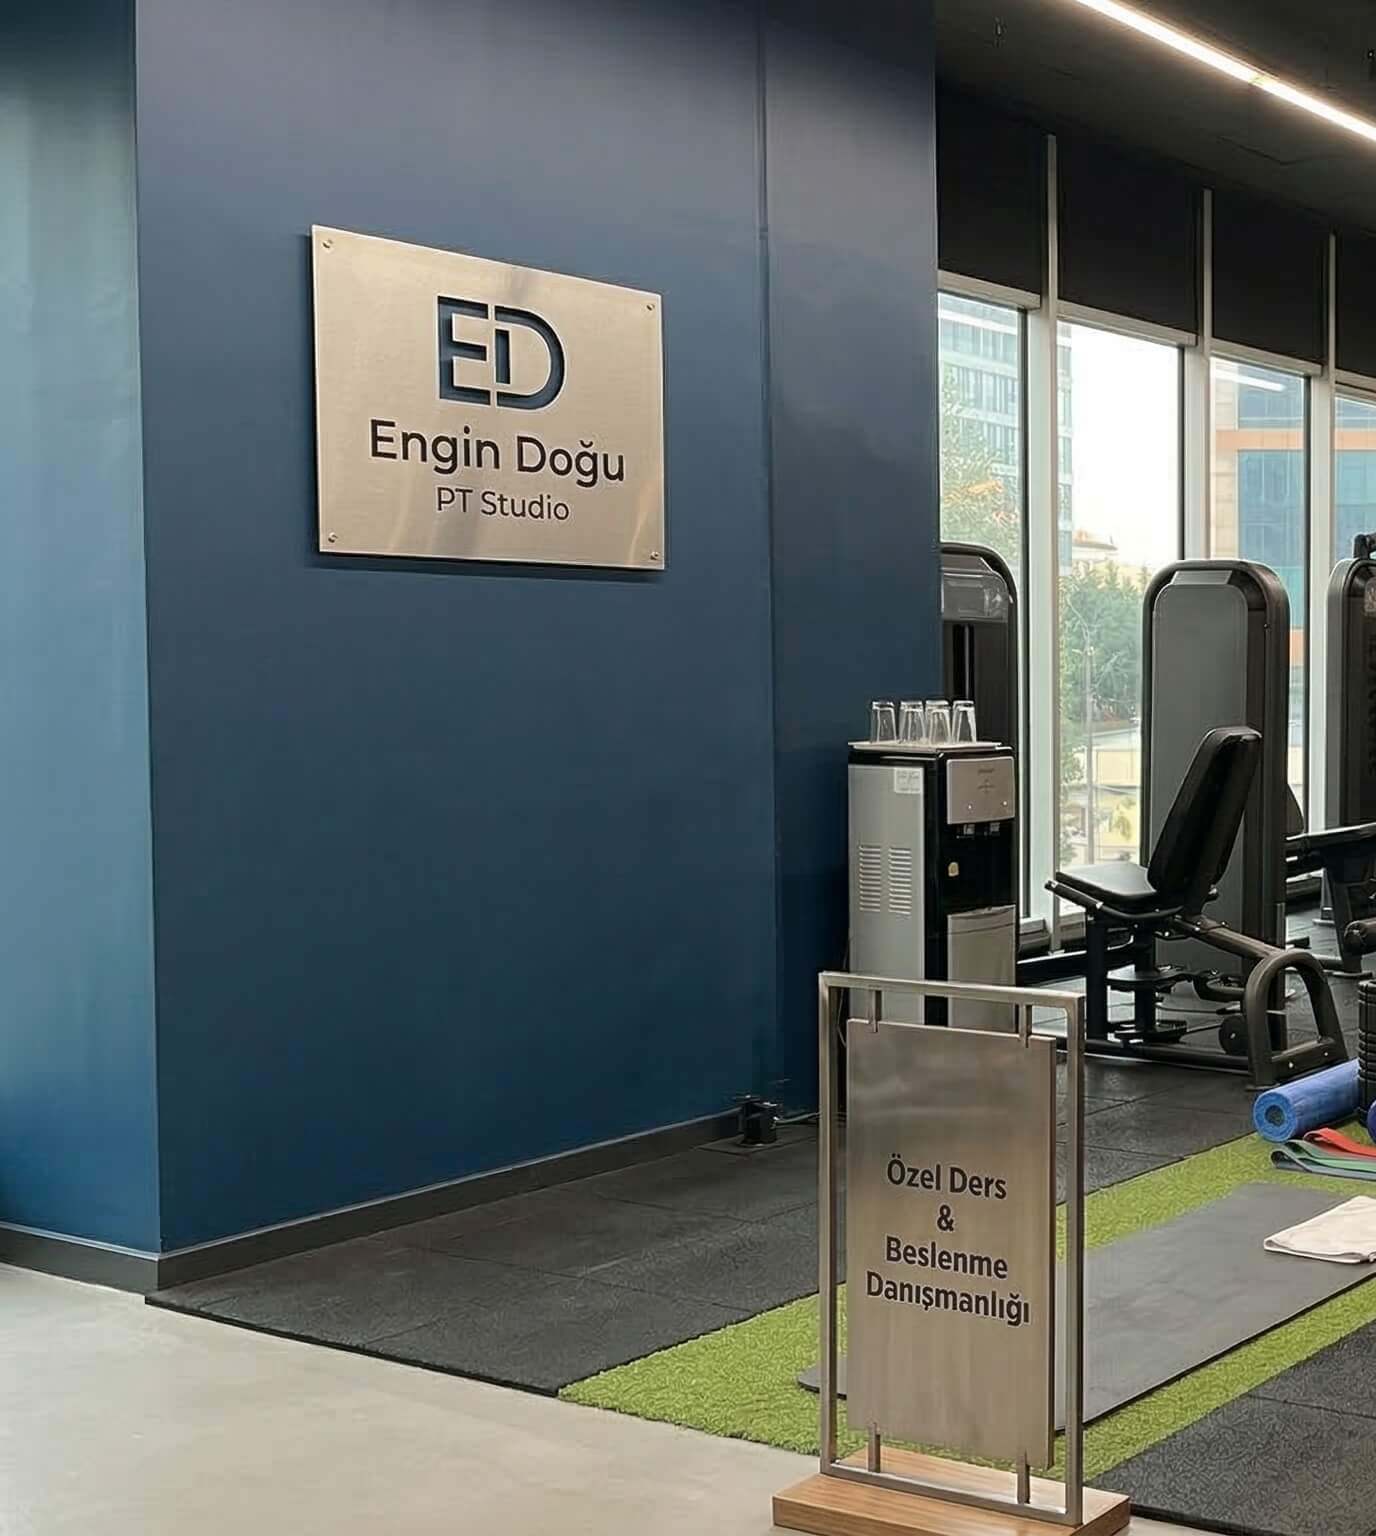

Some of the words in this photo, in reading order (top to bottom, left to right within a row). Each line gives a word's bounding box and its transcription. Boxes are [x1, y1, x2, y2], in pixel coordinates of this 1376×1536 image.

[437, 295, 565, 411] ED
[370, 418, 500, 475] Engin
[516, 435, 625, 488] Doğu
[437, 486, 473, 513] PT
[481, 490, 570, 521] Studio
[886, 1152, 942, 1192] Özel
[948, 1166, 1008, 1200] Ders
[936, 1203, 955, 1233] &
[885, 1235, 1009, 1280] Beslenme
[865, 1270, 1031, 1327] Danışmanlığı
